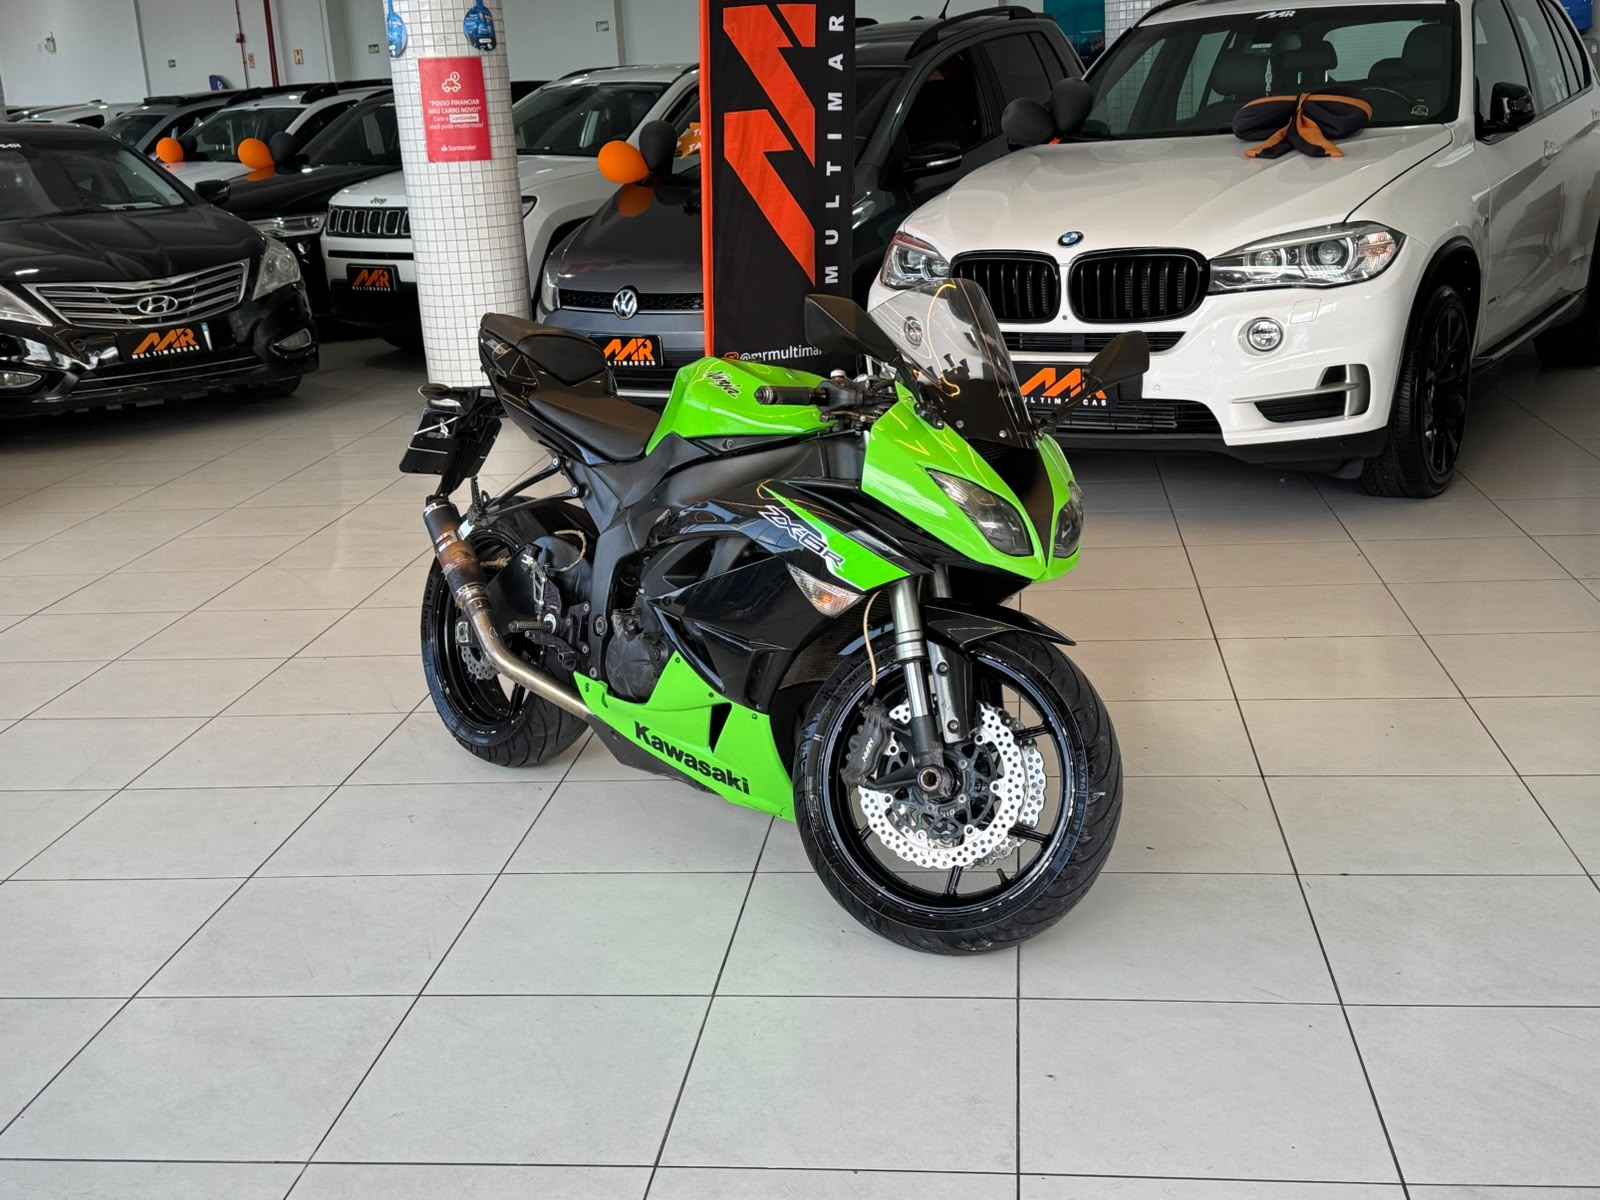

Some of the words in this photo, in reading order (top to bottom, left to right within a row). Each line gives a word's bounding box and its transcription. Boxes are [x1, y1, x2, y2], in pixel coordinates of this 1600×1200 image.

[824, 14, 845, 285] MULTIMAR
[132, 345, 200, 359] MULTIMARCAS
[634, 720, 750, 795] Kawasaki
